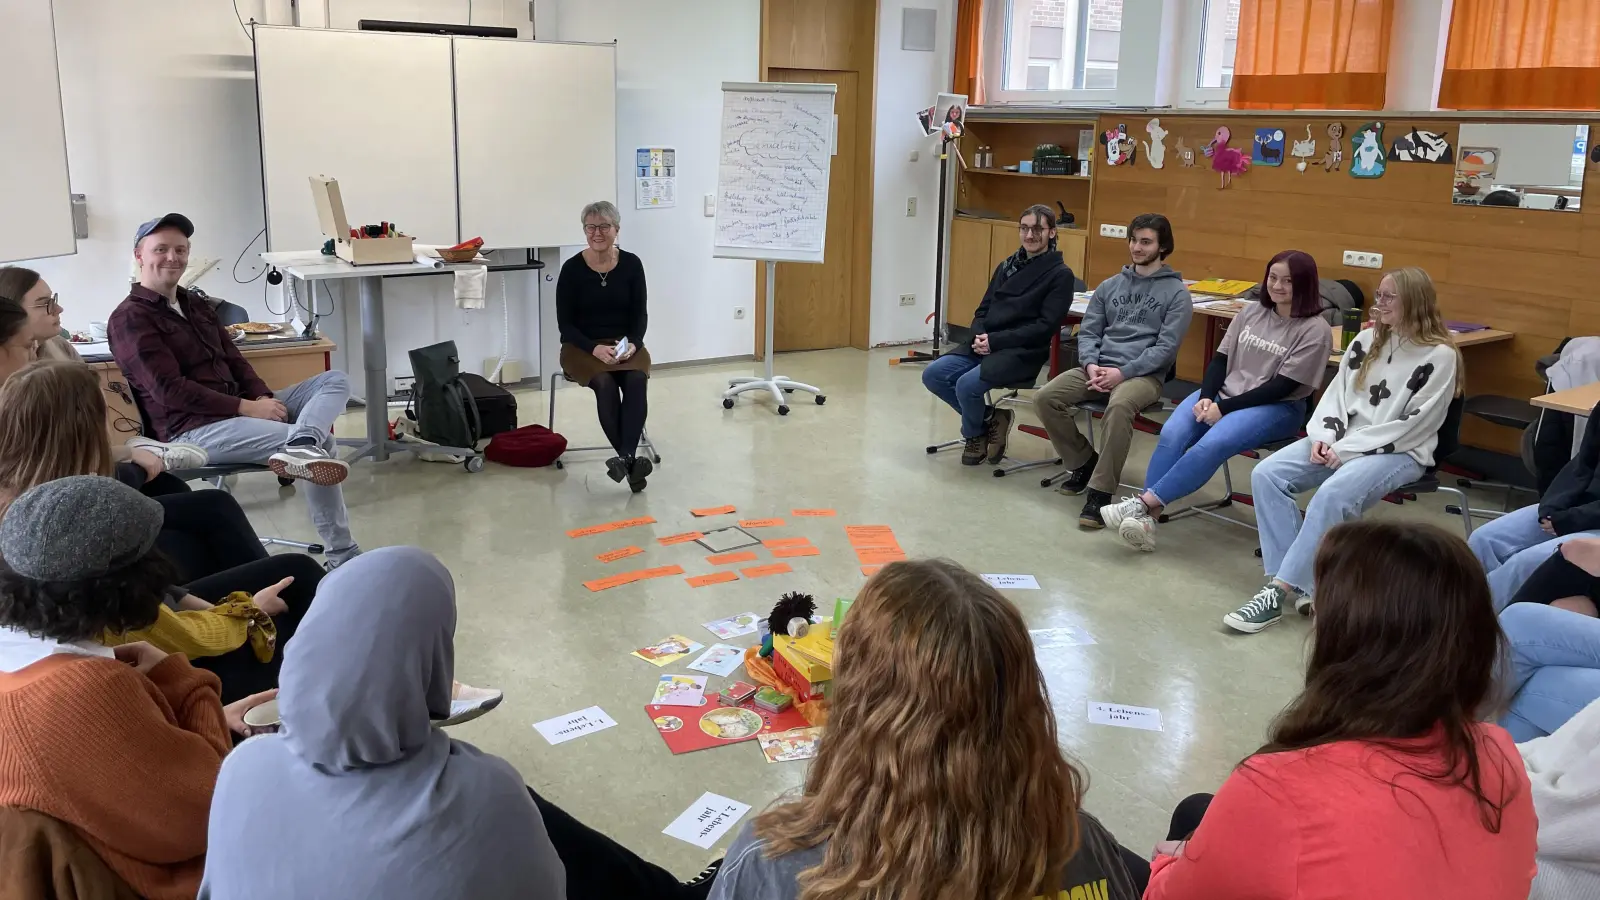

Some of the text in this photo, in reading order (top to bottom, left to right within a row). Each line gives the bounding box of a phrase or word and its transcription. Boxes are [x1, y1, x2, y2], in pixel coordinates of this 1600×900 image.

[1109, 707, 1150, 716] Lebens-
[554, 721, 594, 736] Lebens-
[699, 812, 730, 838] Lebens-
